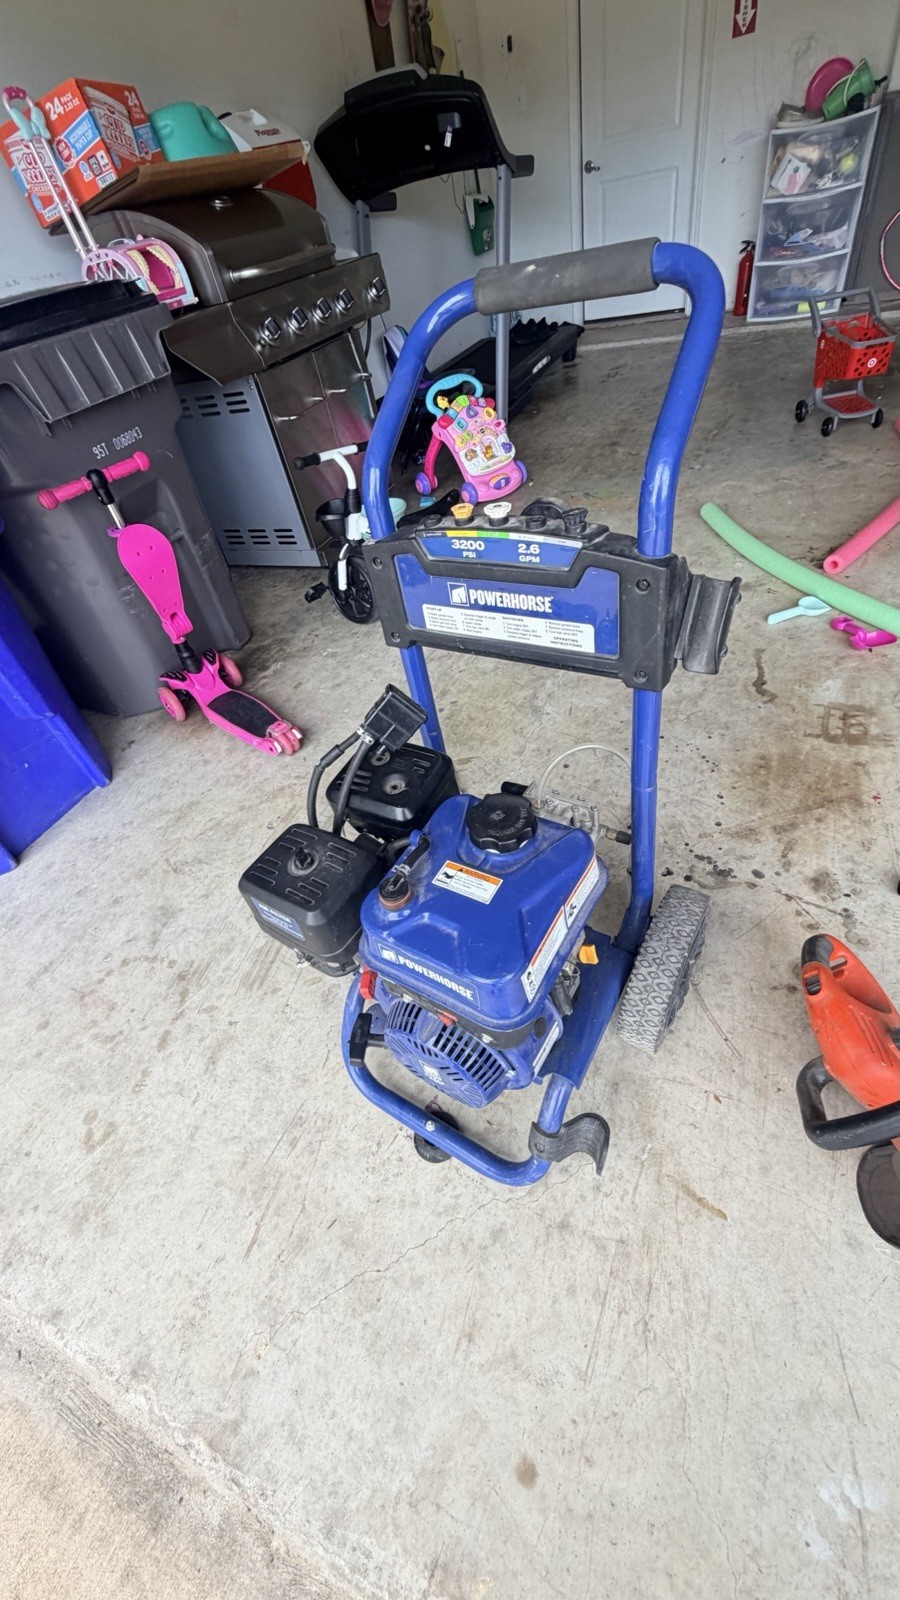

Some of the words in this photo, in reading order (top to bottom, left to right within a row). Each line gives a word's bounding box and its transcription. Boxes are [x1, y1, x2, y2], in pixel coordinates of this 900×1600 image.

[45, 96, 65, 121] 24
[60, 92, 73, 104] PACK
[92, 442, 109, 459] 95T
[112, 426, 143, 450] 0068043
[451, 539, 485, 551] 3200
[517, 543, 540, 554] 2.6
[518, 555, 540, 563] GPM
[468, 589, 553, 614] POWERHORSE
[397, 955, 474, 1001] POWERHORSE
